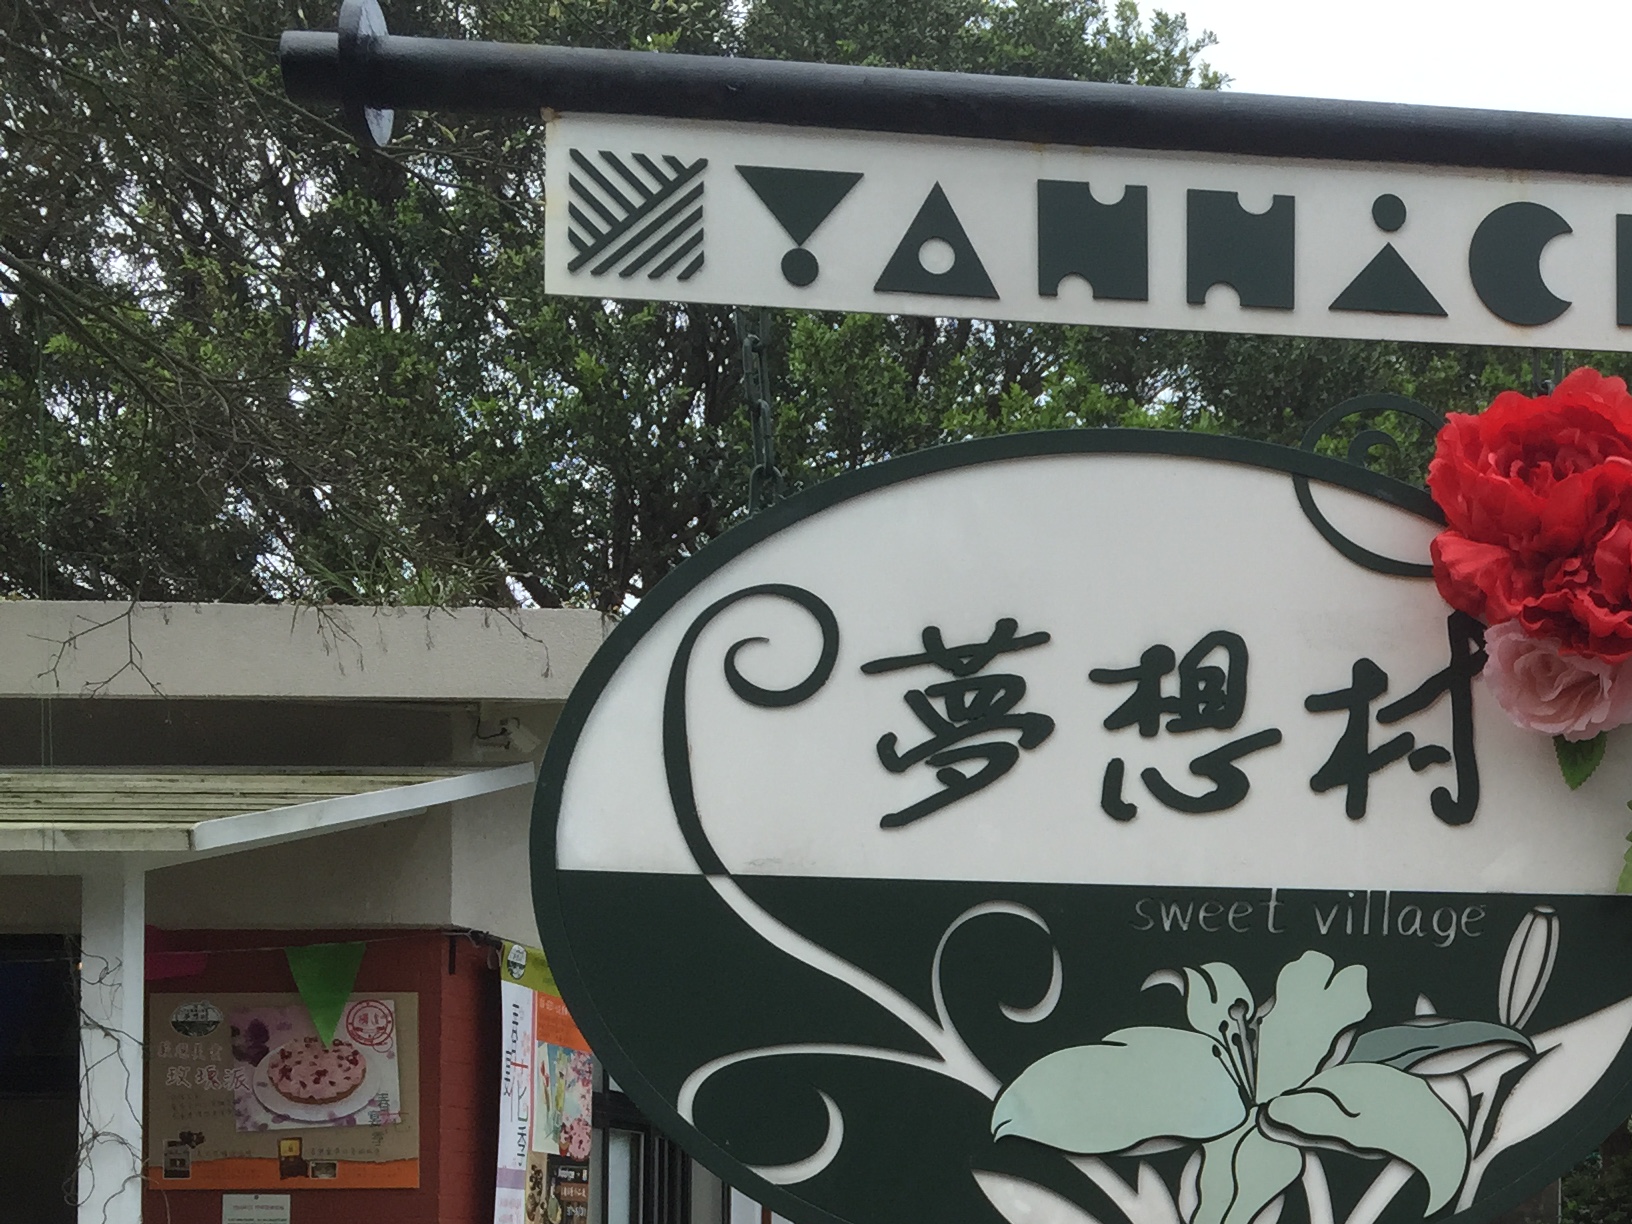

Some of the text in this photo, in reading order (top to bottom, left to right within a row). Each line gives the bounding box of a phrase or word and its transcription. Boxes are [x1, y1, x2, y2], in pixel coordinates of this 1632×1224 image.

[861, 610, 1488, 828] 夢想村
[1131, 887, 1488, 948] sweet village
